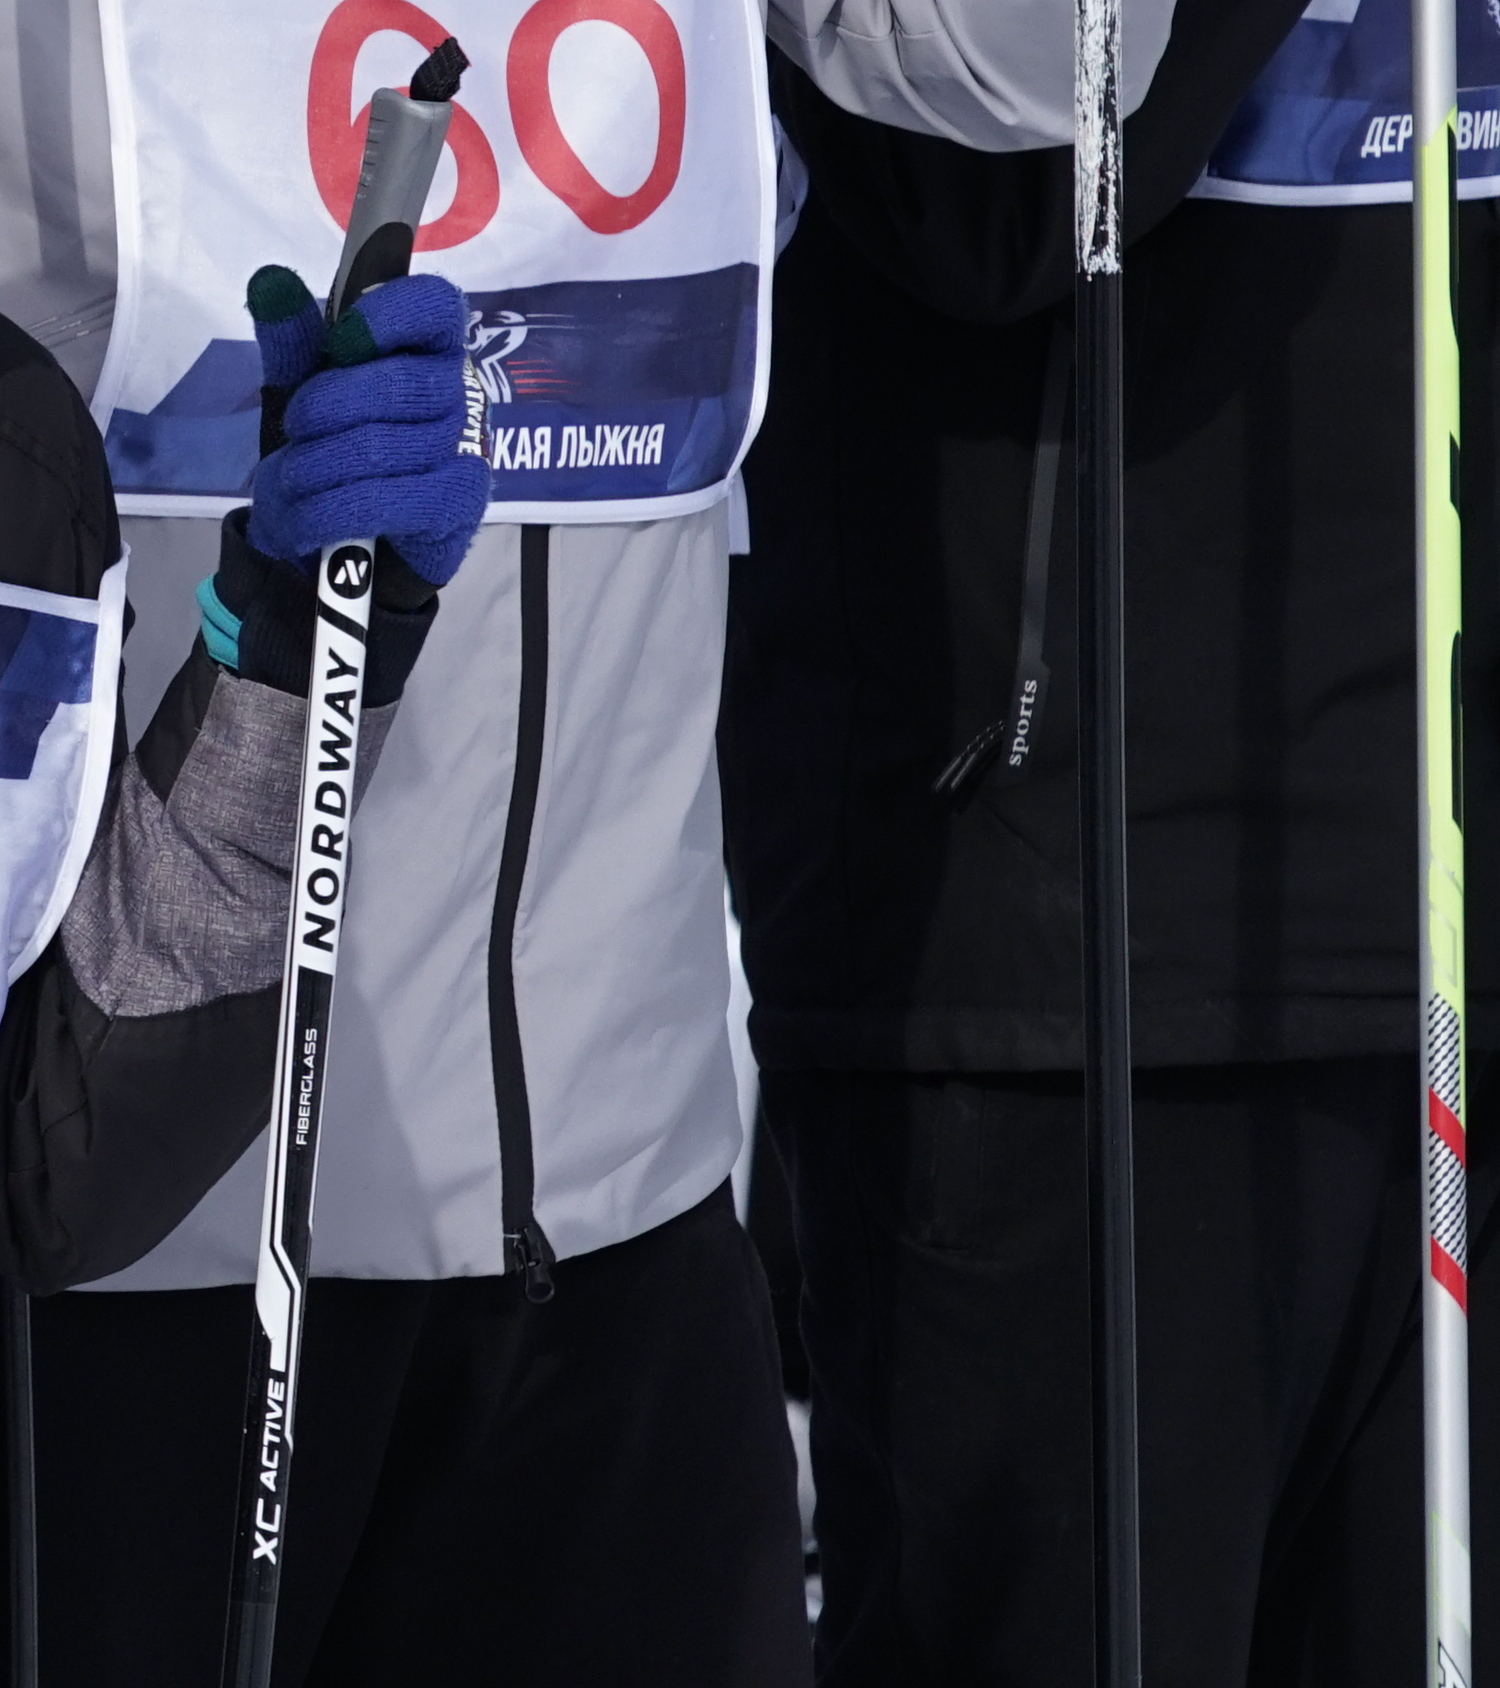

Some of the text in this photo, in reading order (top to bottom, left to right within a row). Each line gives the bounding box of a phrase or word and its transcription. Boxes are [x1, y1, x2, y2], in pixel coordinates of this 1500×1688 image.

[557, 423, 666, 470] ЛЫЖНЯ
[1008, 678, 1038, 767] sports
[302, 646, 360, 953] NORDWAY
[296, 1027, 319, 1146] FIBERGLASS
[252, 1377, 286, 1566] XC ACTIVE
